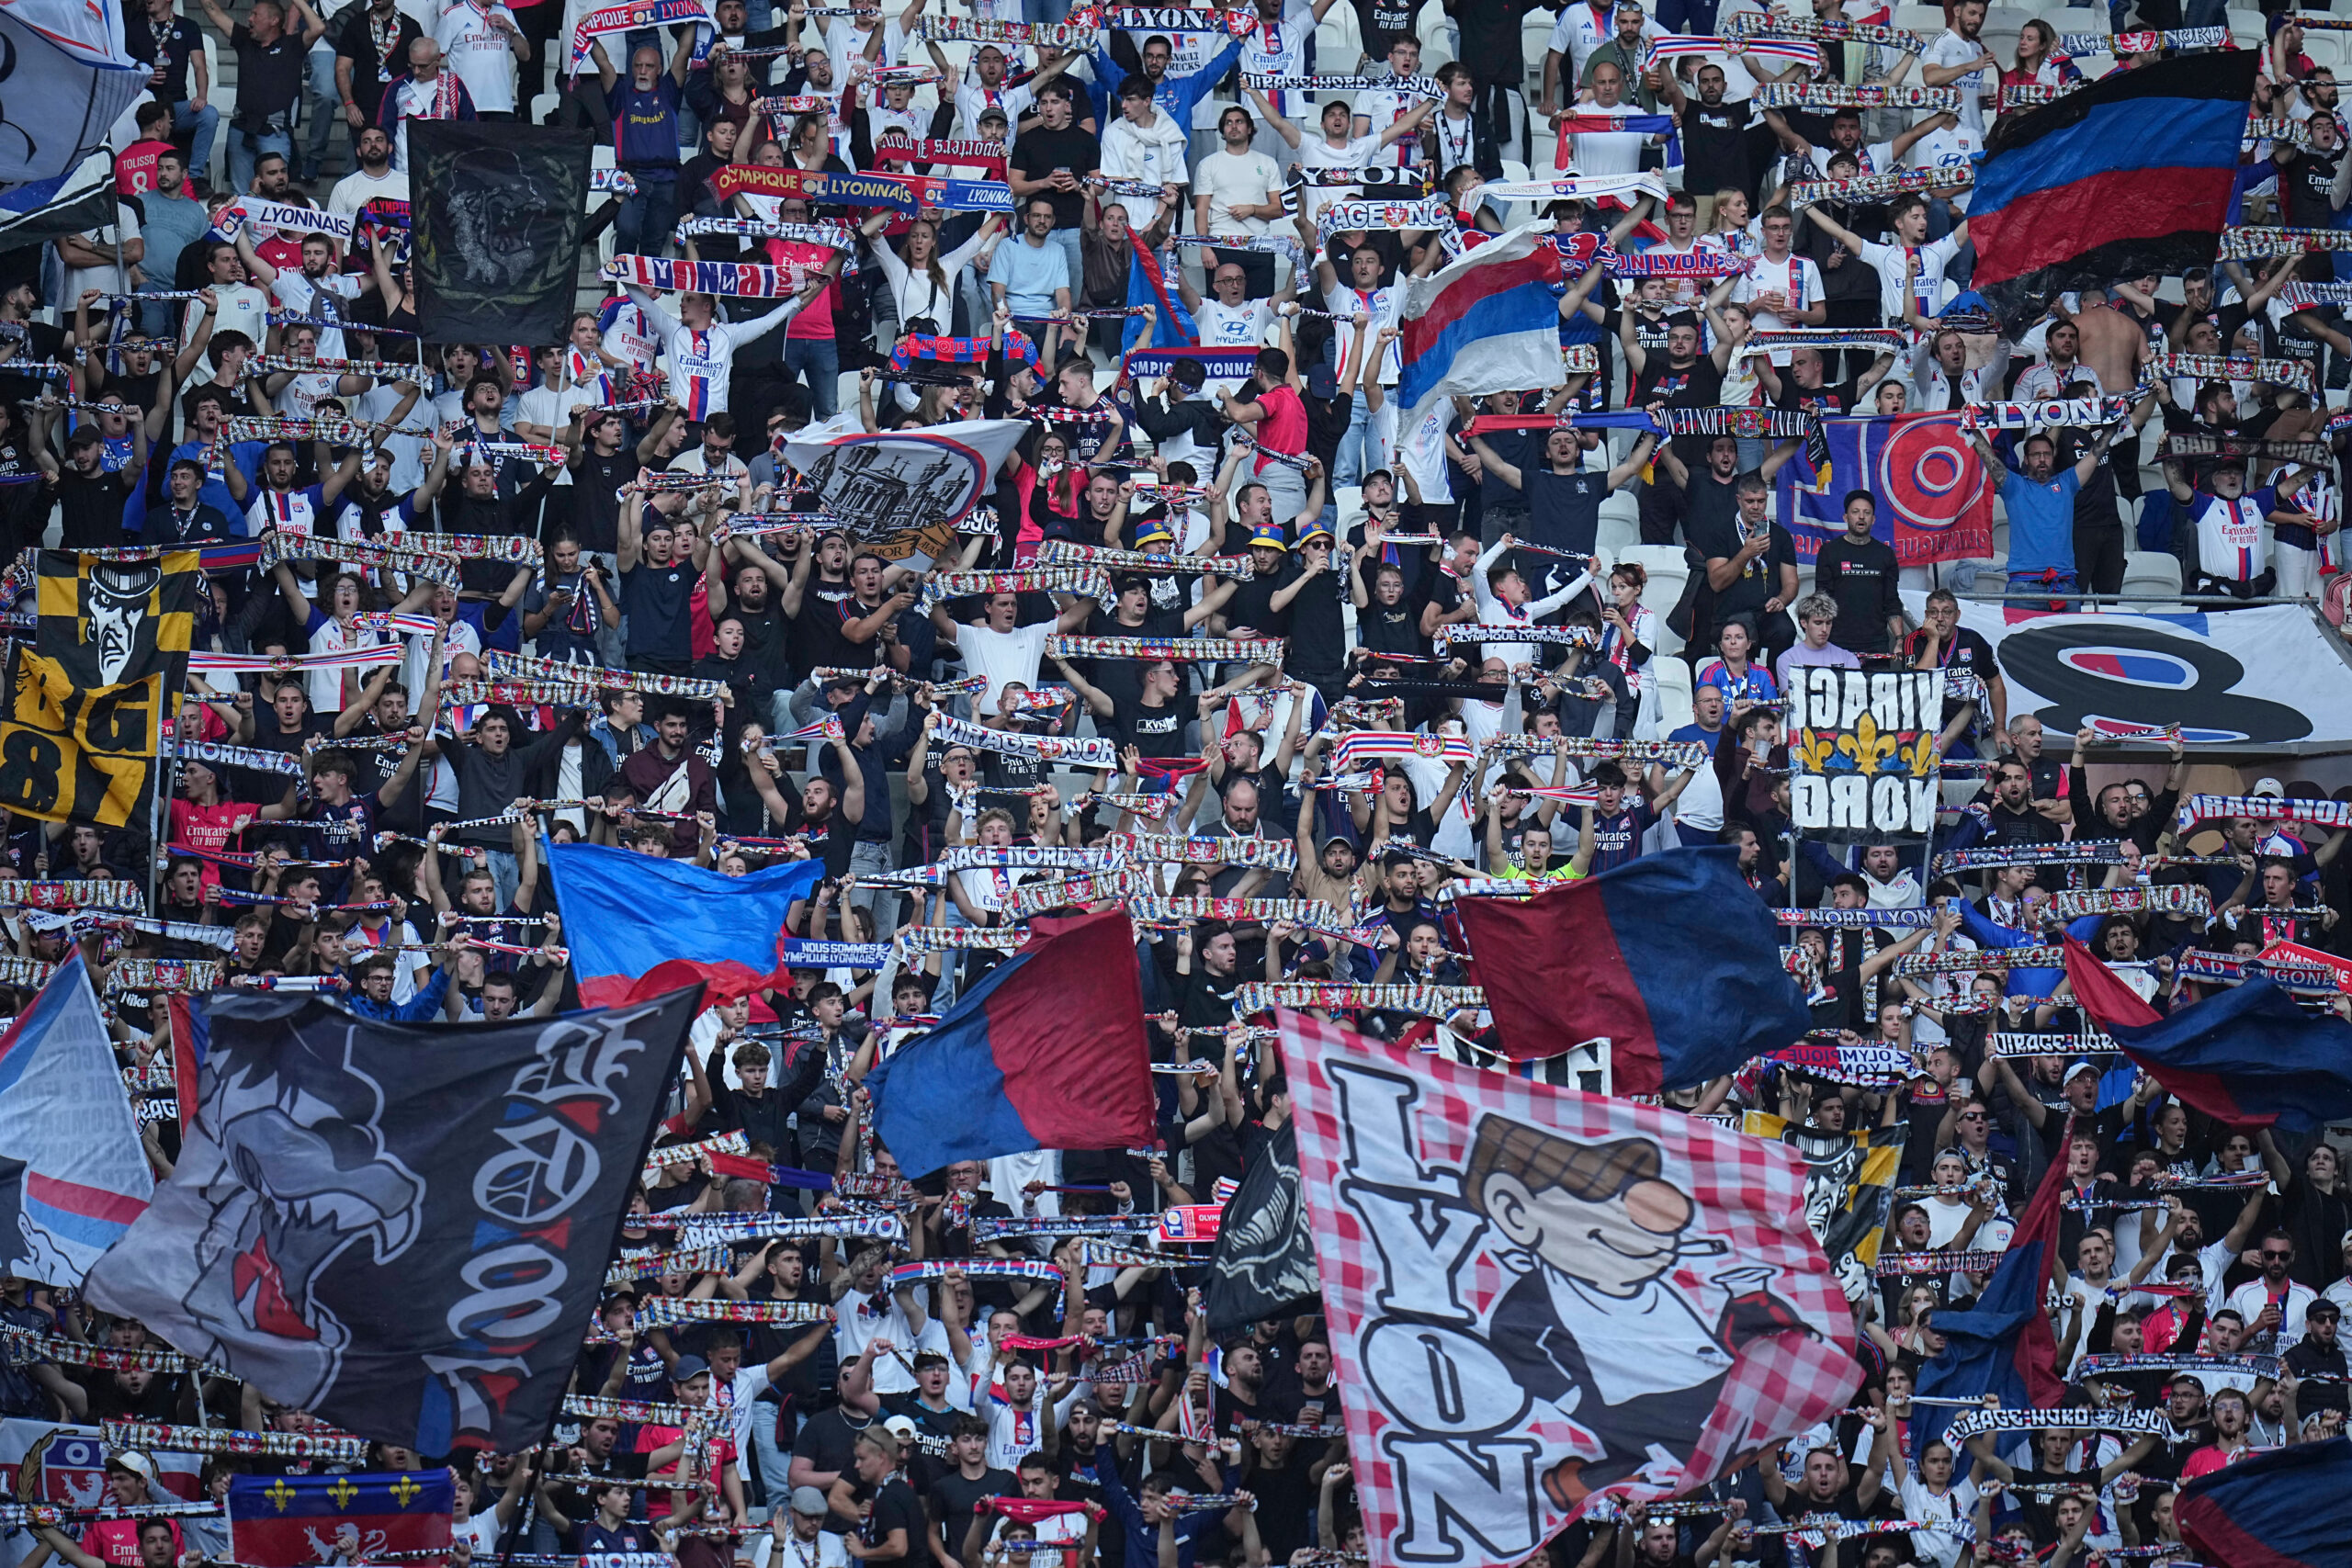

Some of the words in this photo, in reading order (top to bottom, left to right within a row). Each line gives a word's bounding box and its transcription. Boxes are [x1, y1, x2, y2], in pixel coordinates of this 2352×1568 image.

[1123, 8, 1207, 30] LYON
[122, 153, 155, 170] TOLISSO
[591, 168, 627, 191] LYO
[259, 206, 353, 238] LYONNAIS
[1651, 254, 1714, 272] LYON
[679, 355, 724, 369] Emirates
[1204, 361, 1253, 376] YONNA
[1996, 396, 2103, 427] LYON
[2170, 434, 2218, 455] BAD
[1451, 633, 1517, 644] OLYMPIQUE
[1518, 633, 1575, 645] LYONNAIS
[1145, 719, 1168, 731] KVN
[938, 716, 1037, 757] VIRAGE
[1059, 738, 1115, 763] NOR
[1594, 830, 1632, 842] mirates
[948, 847, 999, 870] RAGE
[1008, 846, 1069, 868] NORD
[1808, 909, 1872, 927] NORD
[1875, 907, 1933, 927] LYON
[801, 942, 830, 953] NOUS
[830, 942, 876, 954] SOMMES
[119, 989, 150, 1009] Nike
